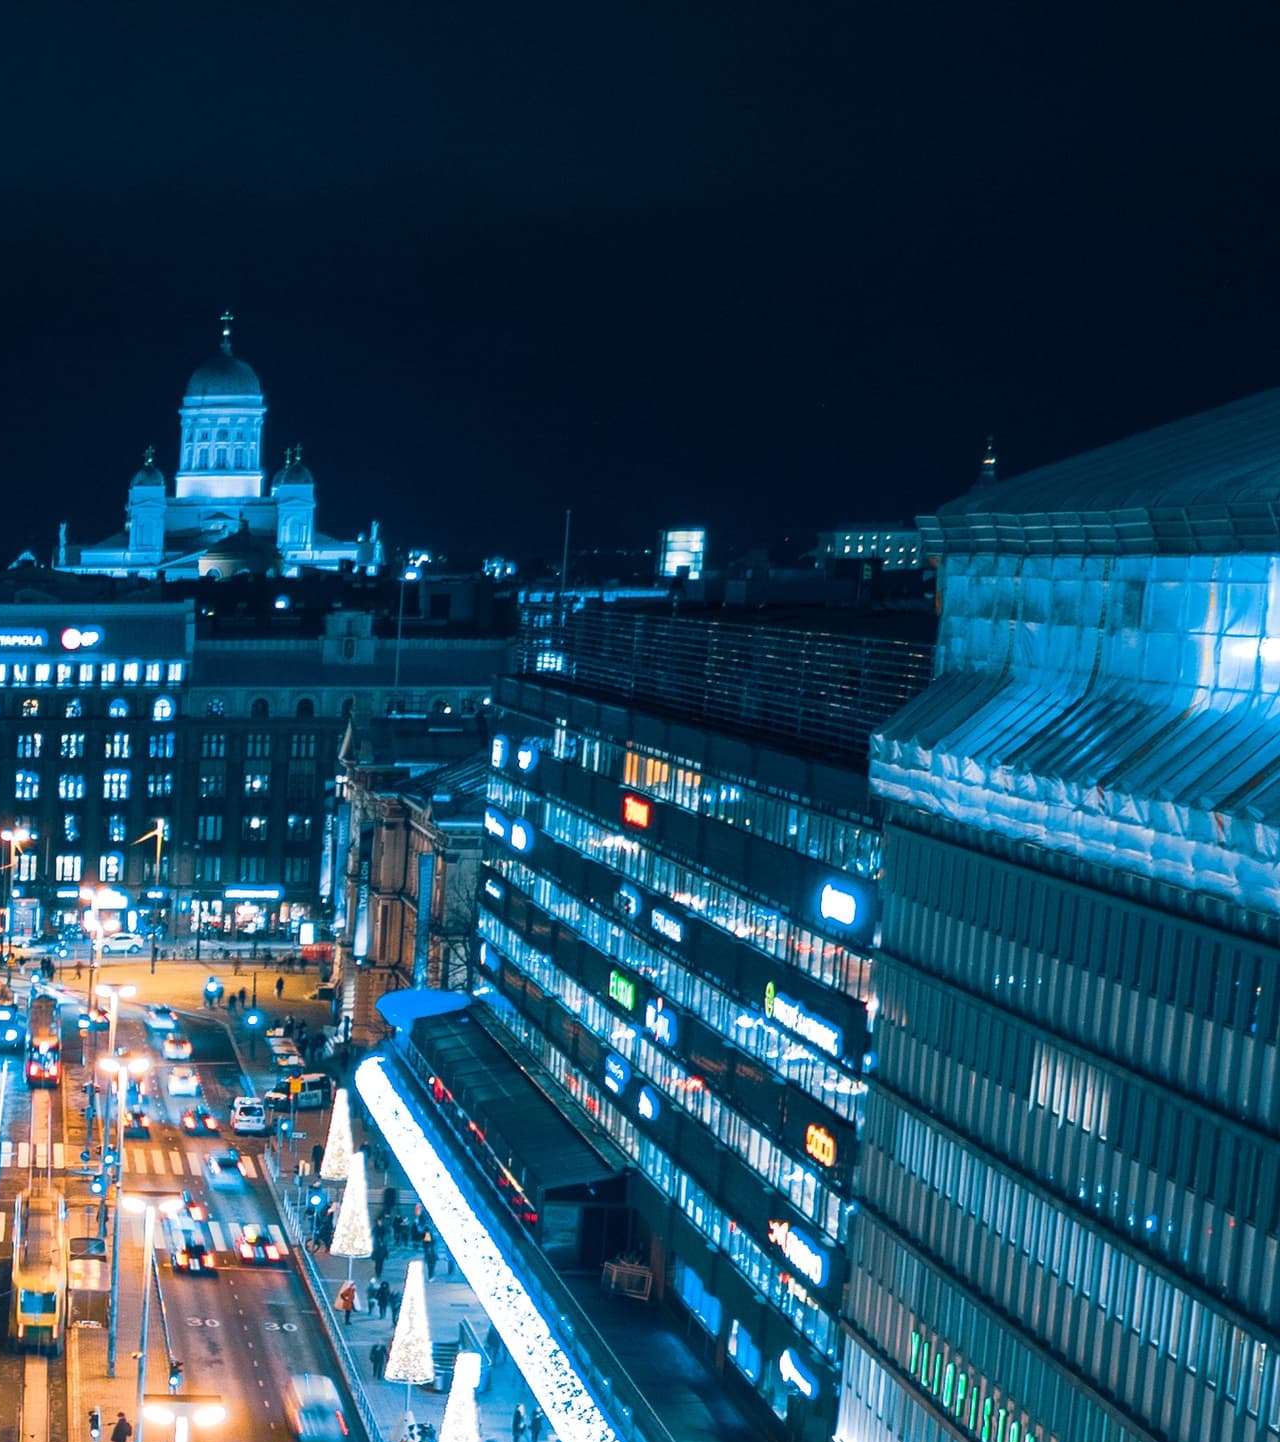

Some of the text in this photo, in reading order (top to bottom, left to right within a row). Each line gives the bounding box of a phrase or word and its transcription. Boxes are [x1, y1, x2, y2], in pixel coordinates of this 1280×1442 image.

[358, 860, 371, 909] NOT VITAL
[185, 1316, 220, 1328] 30
[263, 1321, 298, 1332] 30
